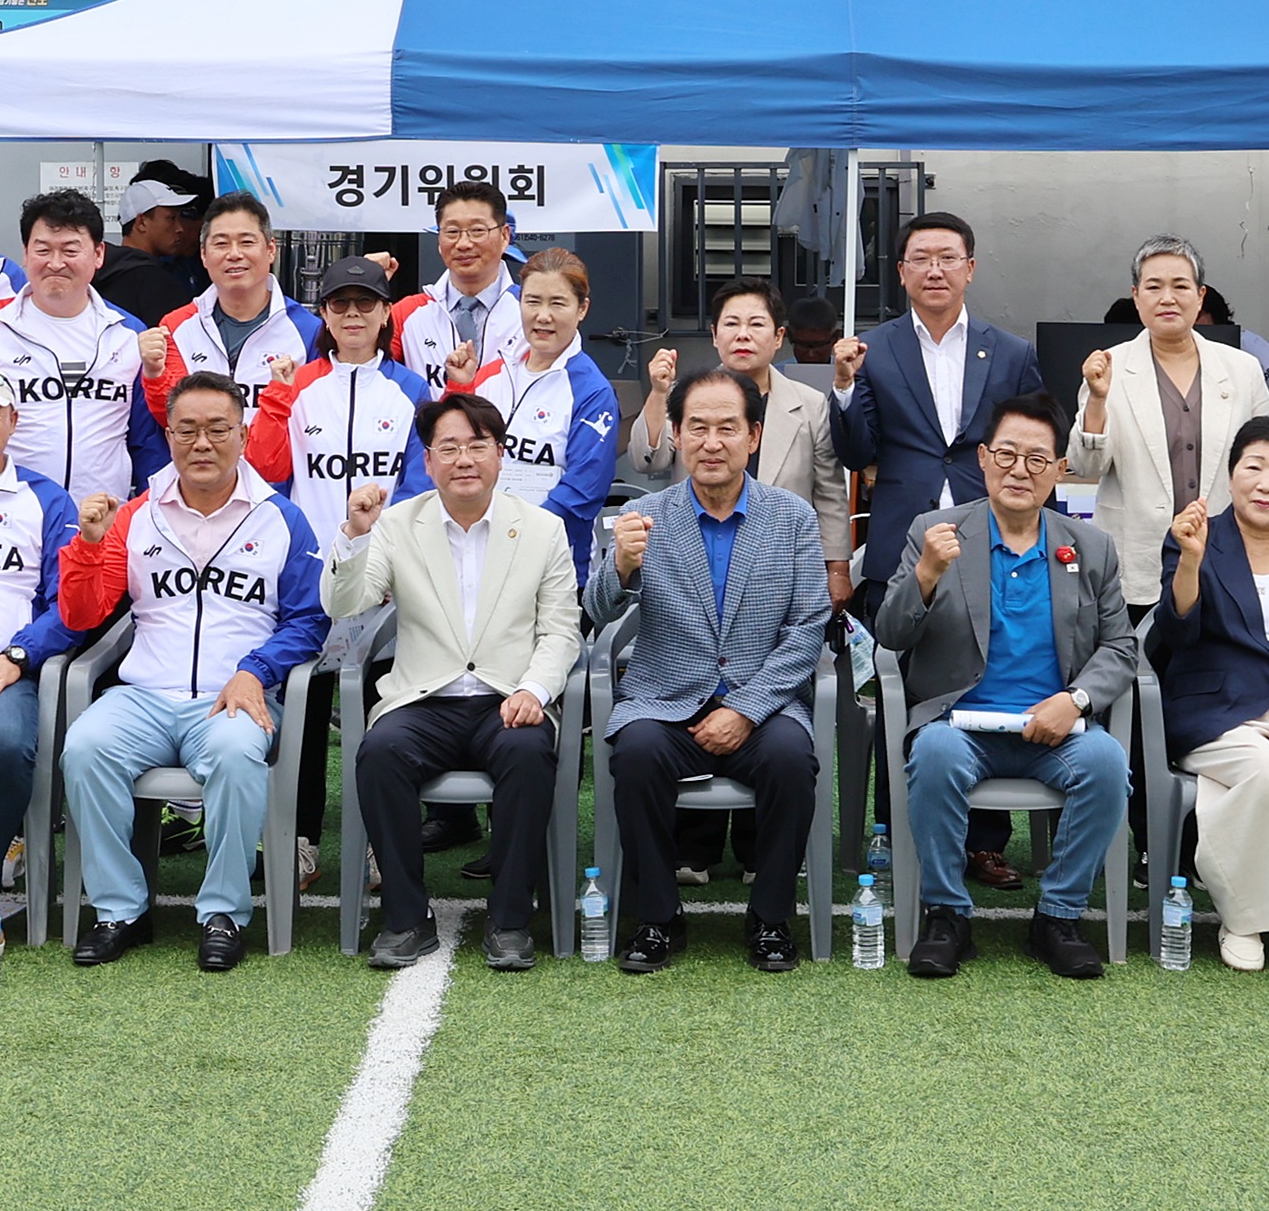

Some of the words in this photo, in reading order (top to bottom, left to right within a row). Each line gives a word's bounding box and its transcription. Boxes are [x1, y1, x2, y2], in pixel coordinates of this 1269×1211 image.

[19, 377, 128, 404] KOREA
[307, 451, 404, 480] KOREA
[151, 566, 267, 606] KOREA
